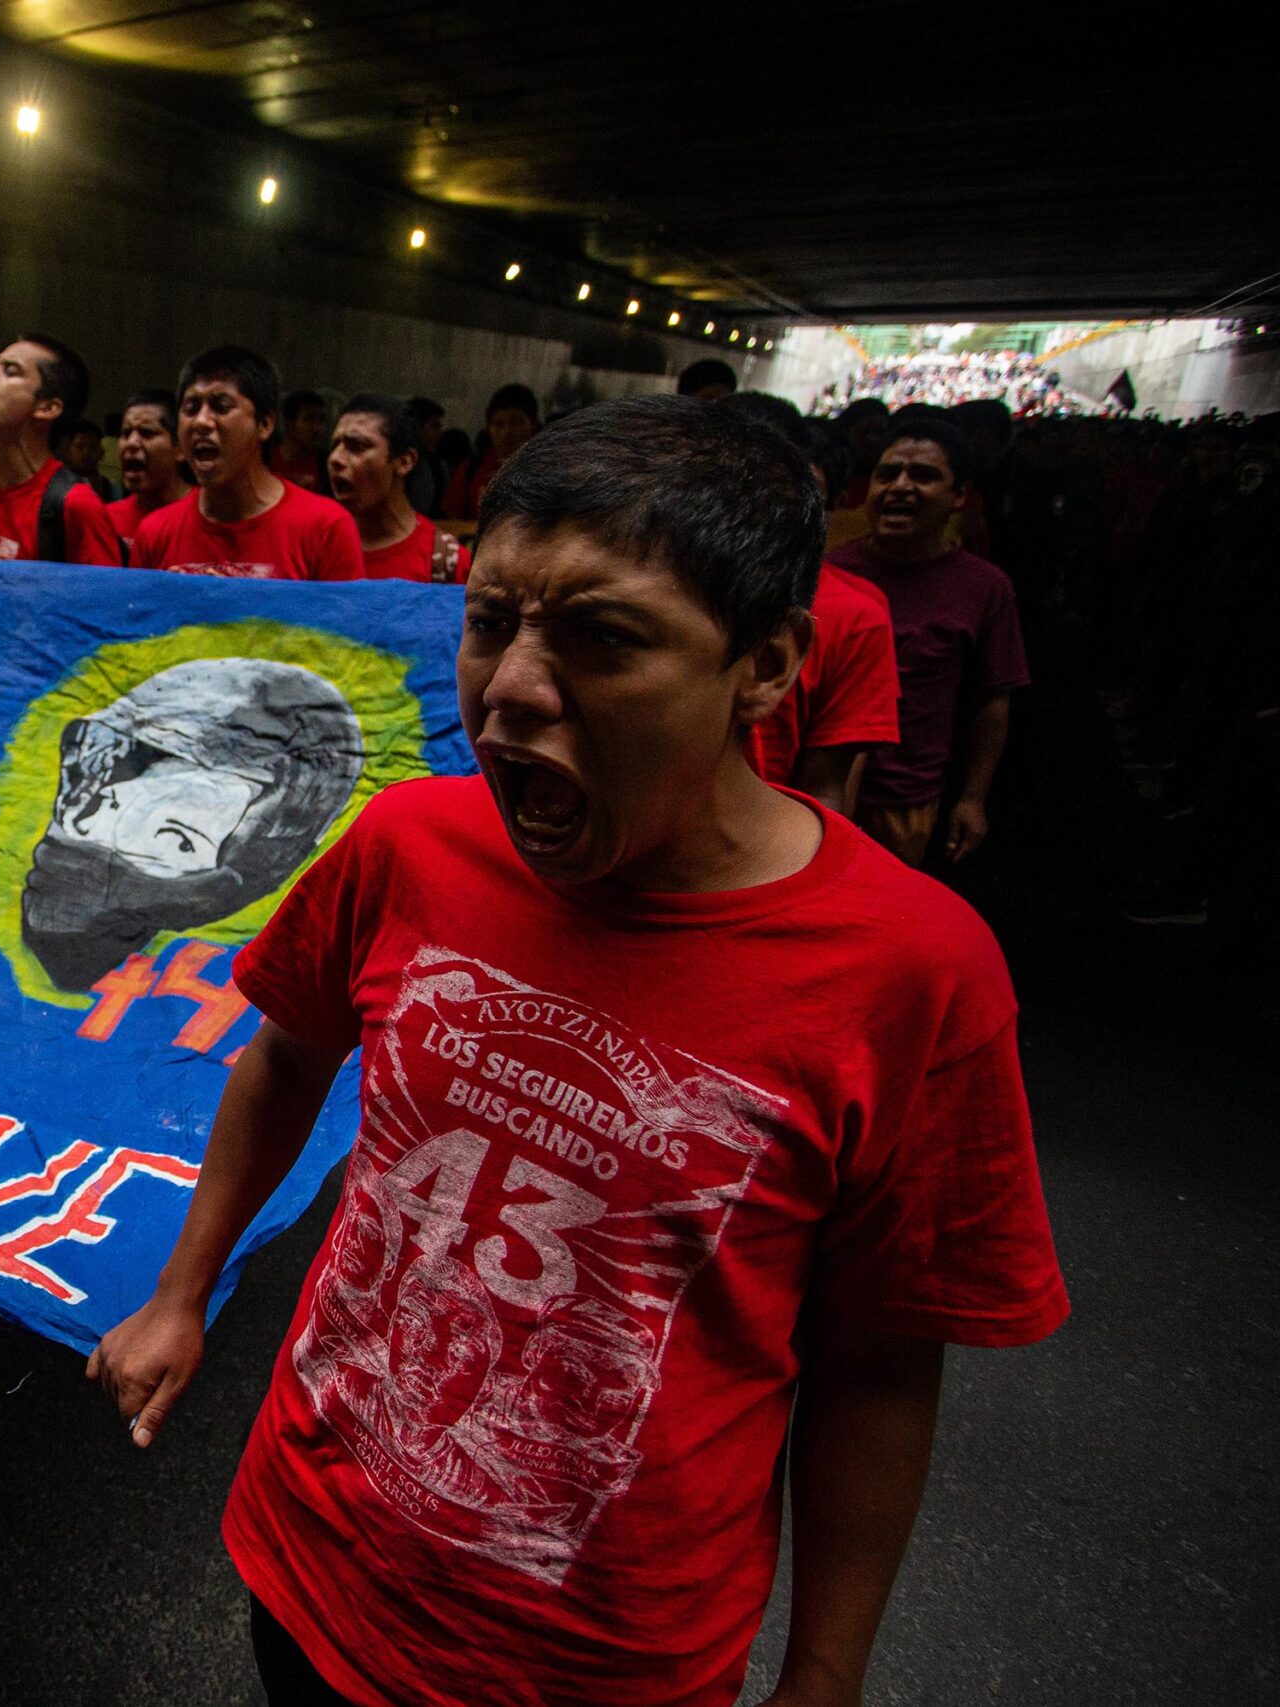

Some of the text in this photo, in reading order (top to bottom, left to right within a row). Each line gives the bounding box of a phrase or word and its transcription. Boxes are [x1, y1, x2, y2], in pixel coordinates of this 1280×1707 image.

[477, 999, 658, 1095] AYOTZINAPA
[421, 1023, 690, 1171] LOS SEGUIREMOS
[444, 1077, 620, 1182] BUSCANDO
[380, 1127, 609, 1312] 43
[353, 1422, 393, 1477] DANIEL
[355, 1442, 422, 1516] GALLARDO
[506, 1439, 552, 1459] JULIO
